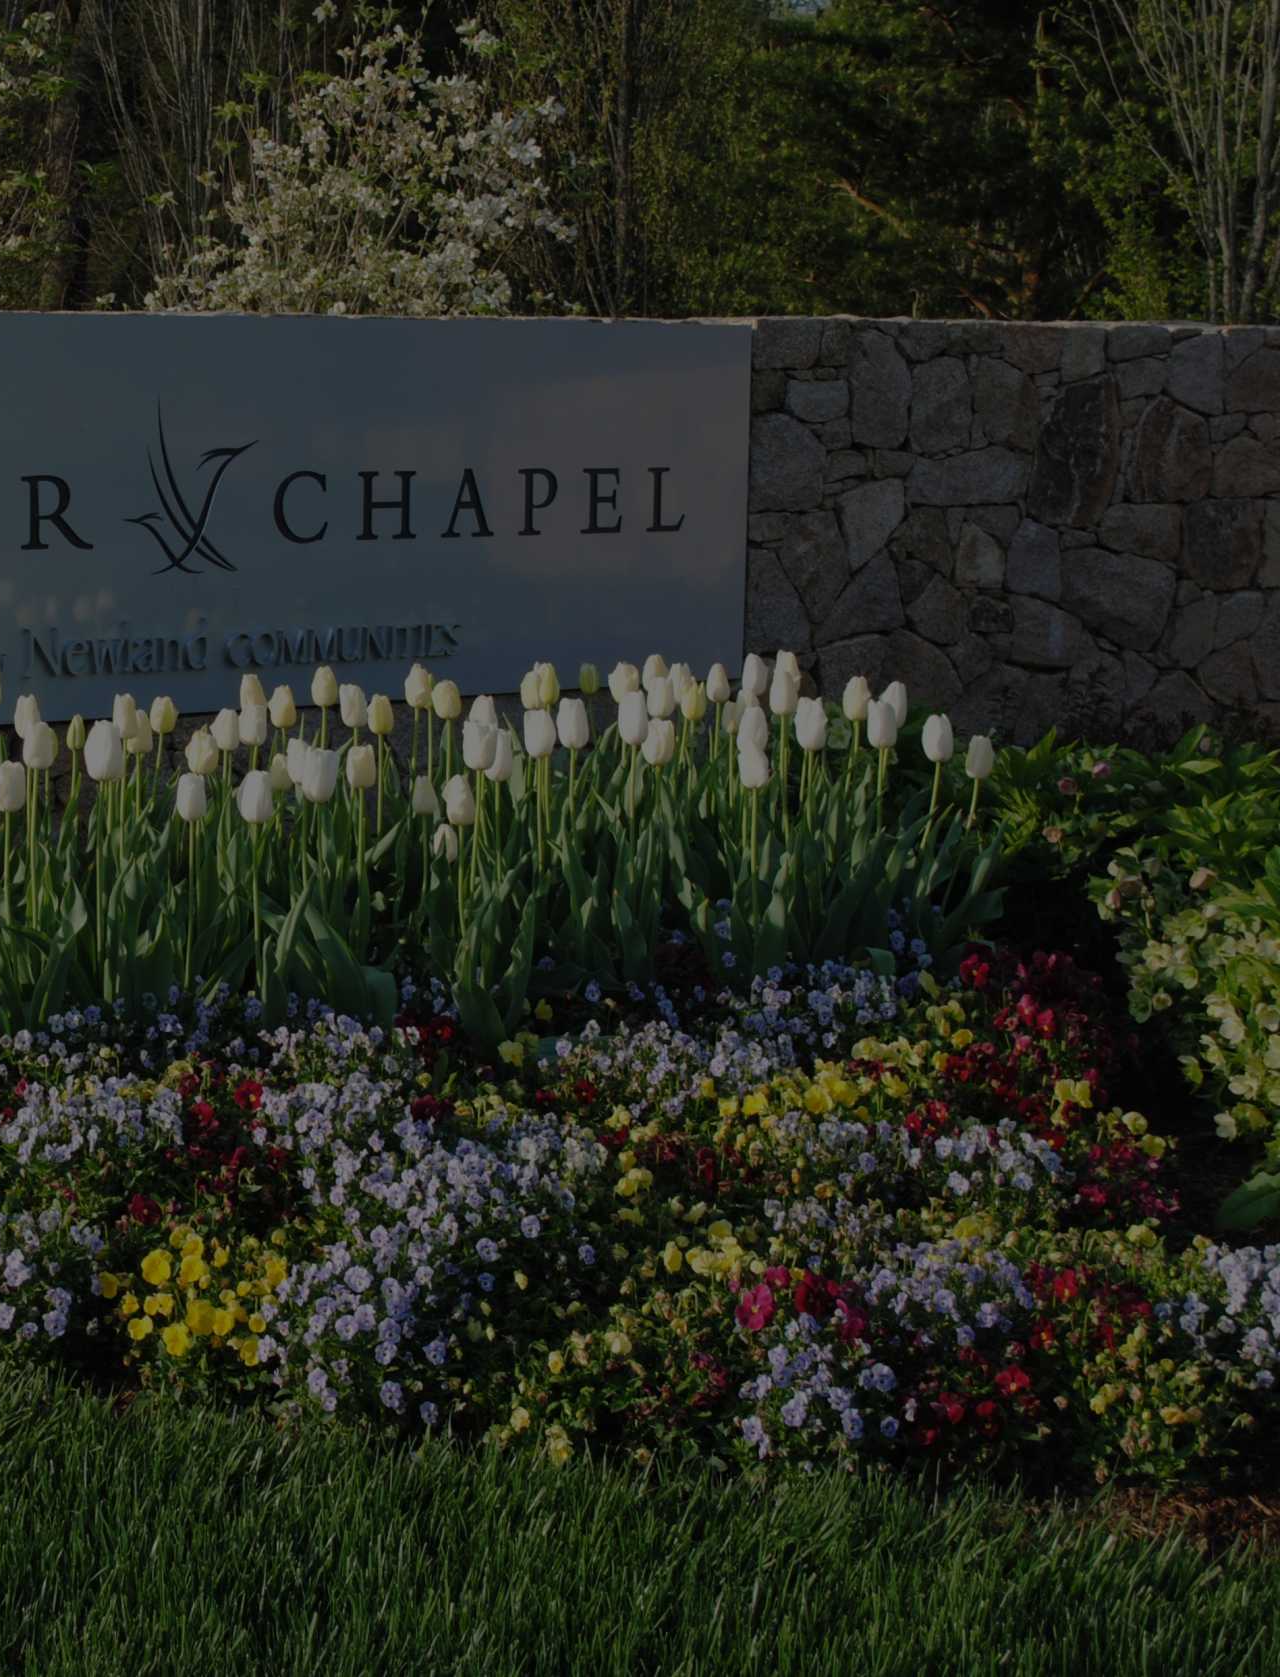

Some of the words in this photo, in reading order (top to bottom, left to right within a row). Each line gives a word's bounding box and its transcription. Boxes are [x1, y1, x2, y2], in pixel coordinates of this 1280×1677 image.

[272, 466, 687, 545] CHAPEL
[22, 617, 209, 680] Newland
[223, 623, 463, 667] COMMUNITIES
